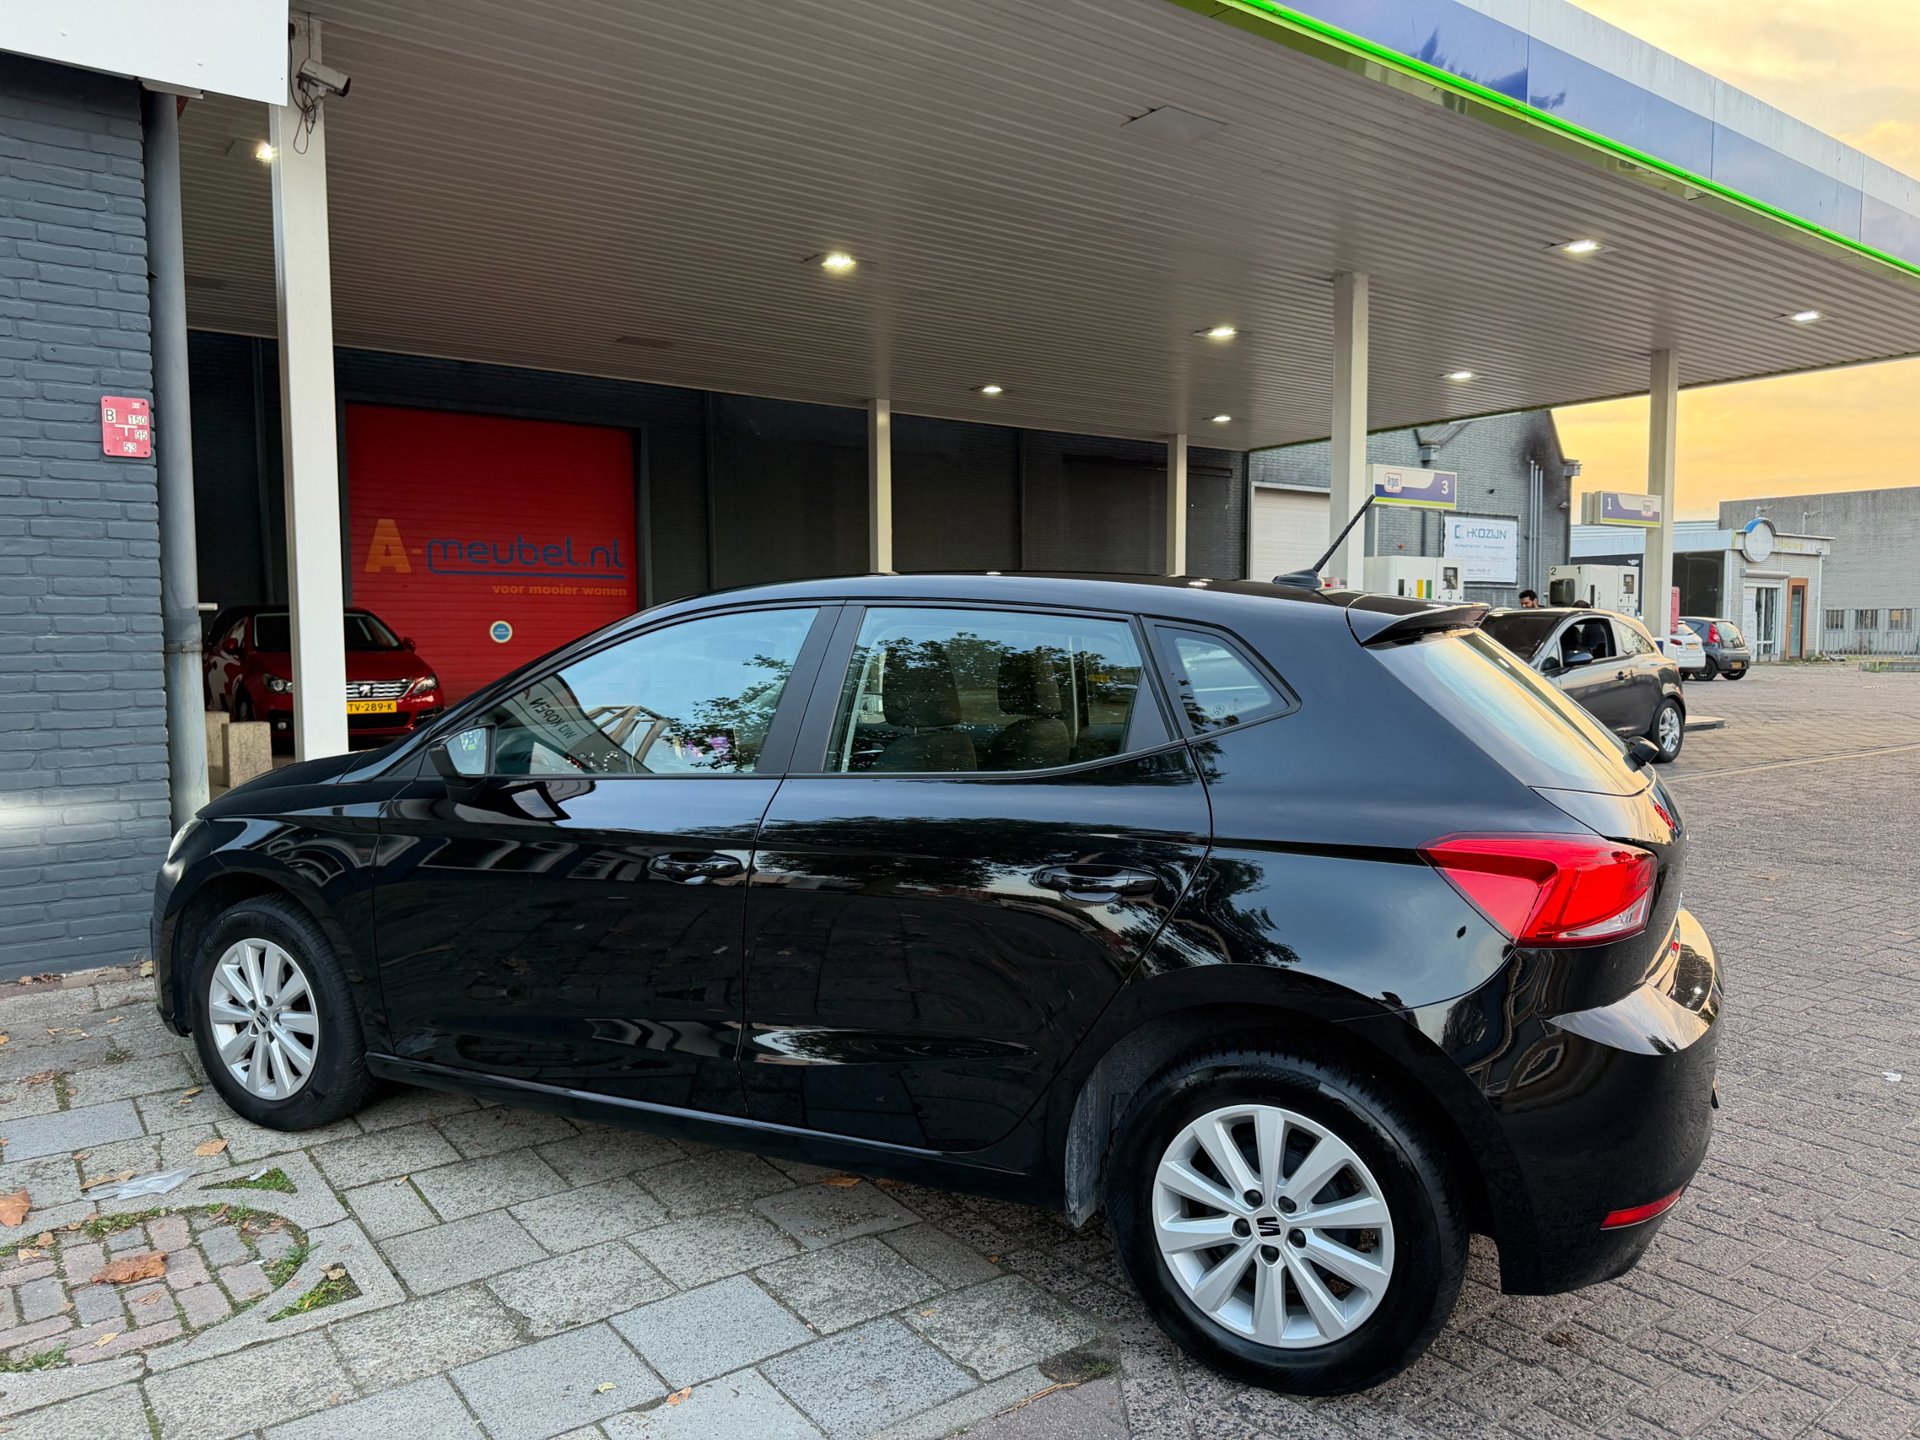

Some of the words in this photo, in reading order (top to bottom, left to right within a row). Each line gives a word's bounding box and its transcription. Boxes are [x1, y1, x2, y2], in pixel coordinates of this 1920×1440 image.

[105, 409, 115, 422] B
[129, 415, 147, 425] 150
[1441, 480, 1449, 494] 3
[1606, 497, 1612, 510] 1
[364, 518, 625, 579] A-meubel.nl
[1550, 567, 1557, 576] 2
[1576, 566, 1582, 575] 1
[492, 584, 525, 595] voor
[529, 584, 579, 596] mooier
[582, 587, 627, 597] wonen
[1448, 590, 1453, 600] 3
